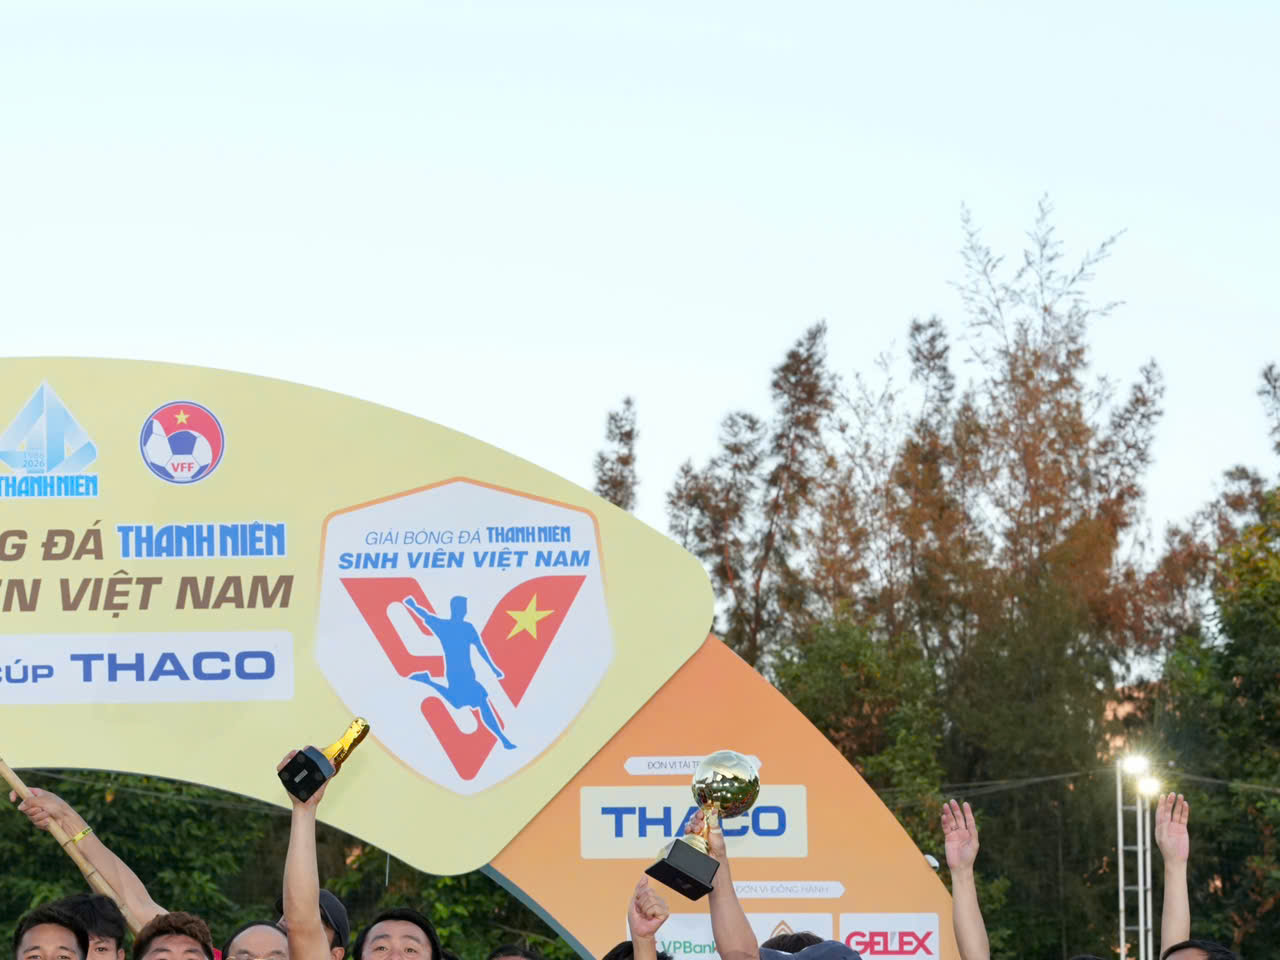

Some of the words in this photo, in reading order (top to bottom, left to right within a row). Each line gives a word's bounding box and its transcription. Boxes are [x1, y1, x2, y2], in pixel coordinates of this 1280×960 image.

[172, 462, 194, 472] VFF
[42, 520, 104, 560] ĐÁ
[404, 528, 453, 544] BÓNG
[458, 528, 481, 543] ĐÁ
[339, 552, 398, 569] SINH
[407, 547, 464, 568] VIÊN
[474, 547, 528, 571] VIỆT
[535, 550, 590, 567] NAM
[60, 569, 162, 618] VIỆT
[176, 575, 294, 609] NAM
[70, 651, 275, 682] THACO
[845, 931, 934, 955] GELEX
